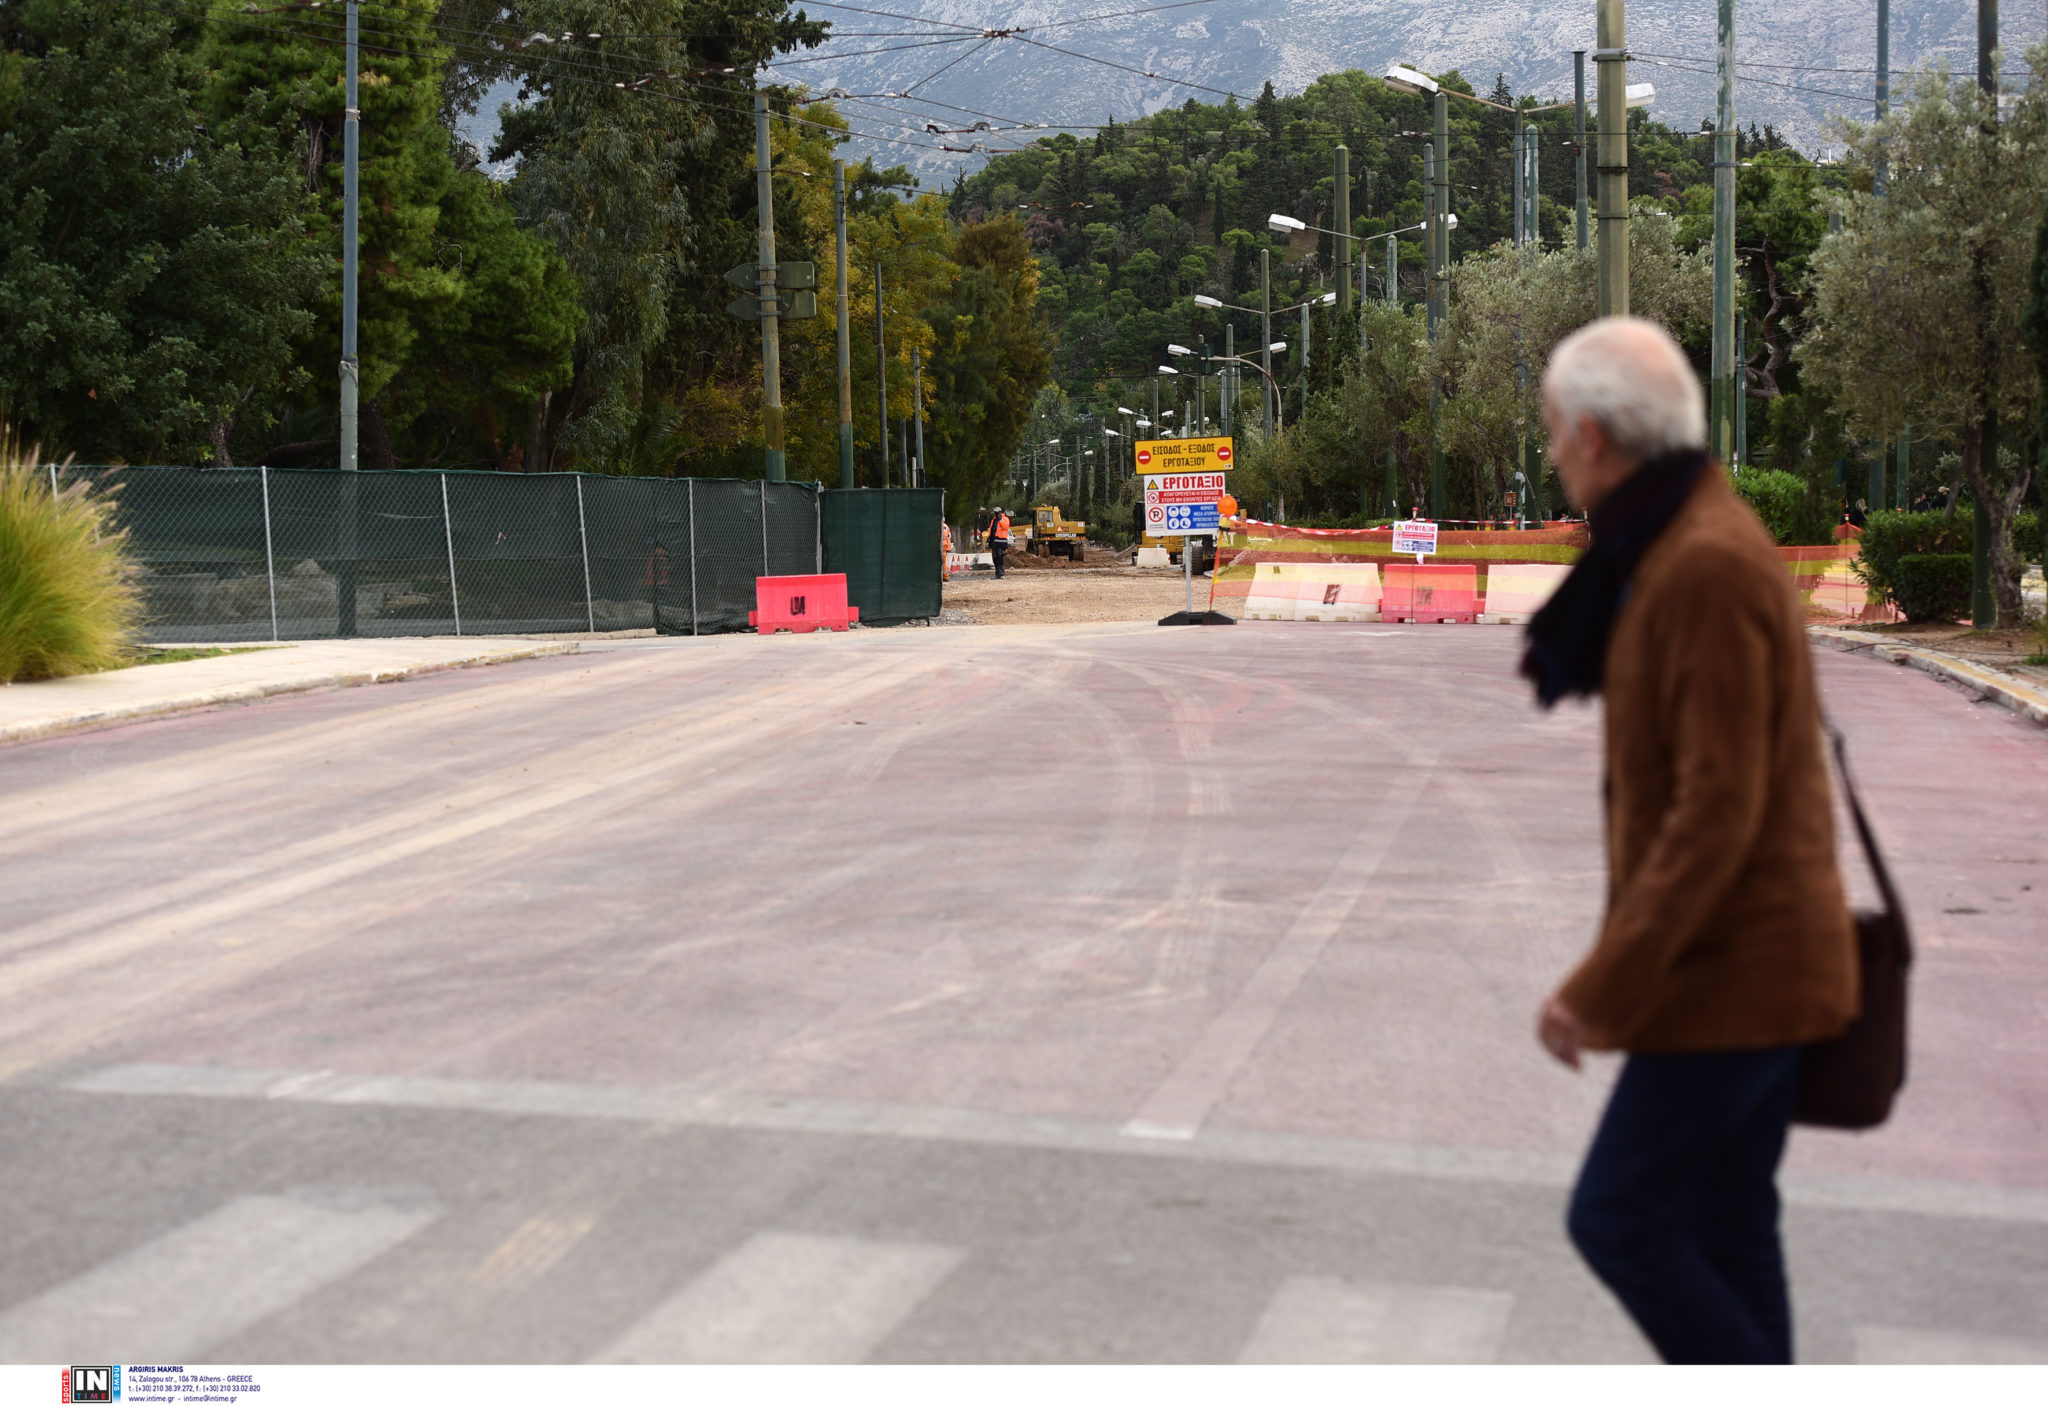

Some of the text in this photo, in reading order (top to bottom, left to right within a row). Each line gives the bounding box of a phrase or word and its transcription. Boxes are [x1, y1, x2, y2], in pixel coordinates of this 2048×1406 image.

[1152, 445, 1182, 455] ΕΙΣΟΔΟΣ
[1188, 443, 1216, 454] ΕΞΟΔΟΣ
[1163, 457, 1206, 468] ΕΡΓΟΤΑΞΙΟΥ
[1163, 475, 1223, 489] ΕΡΓΟΤΑΞΙΟ
[1405, 524, 1436, 532] ΕΡΓΟΤΑΞΙΟ
